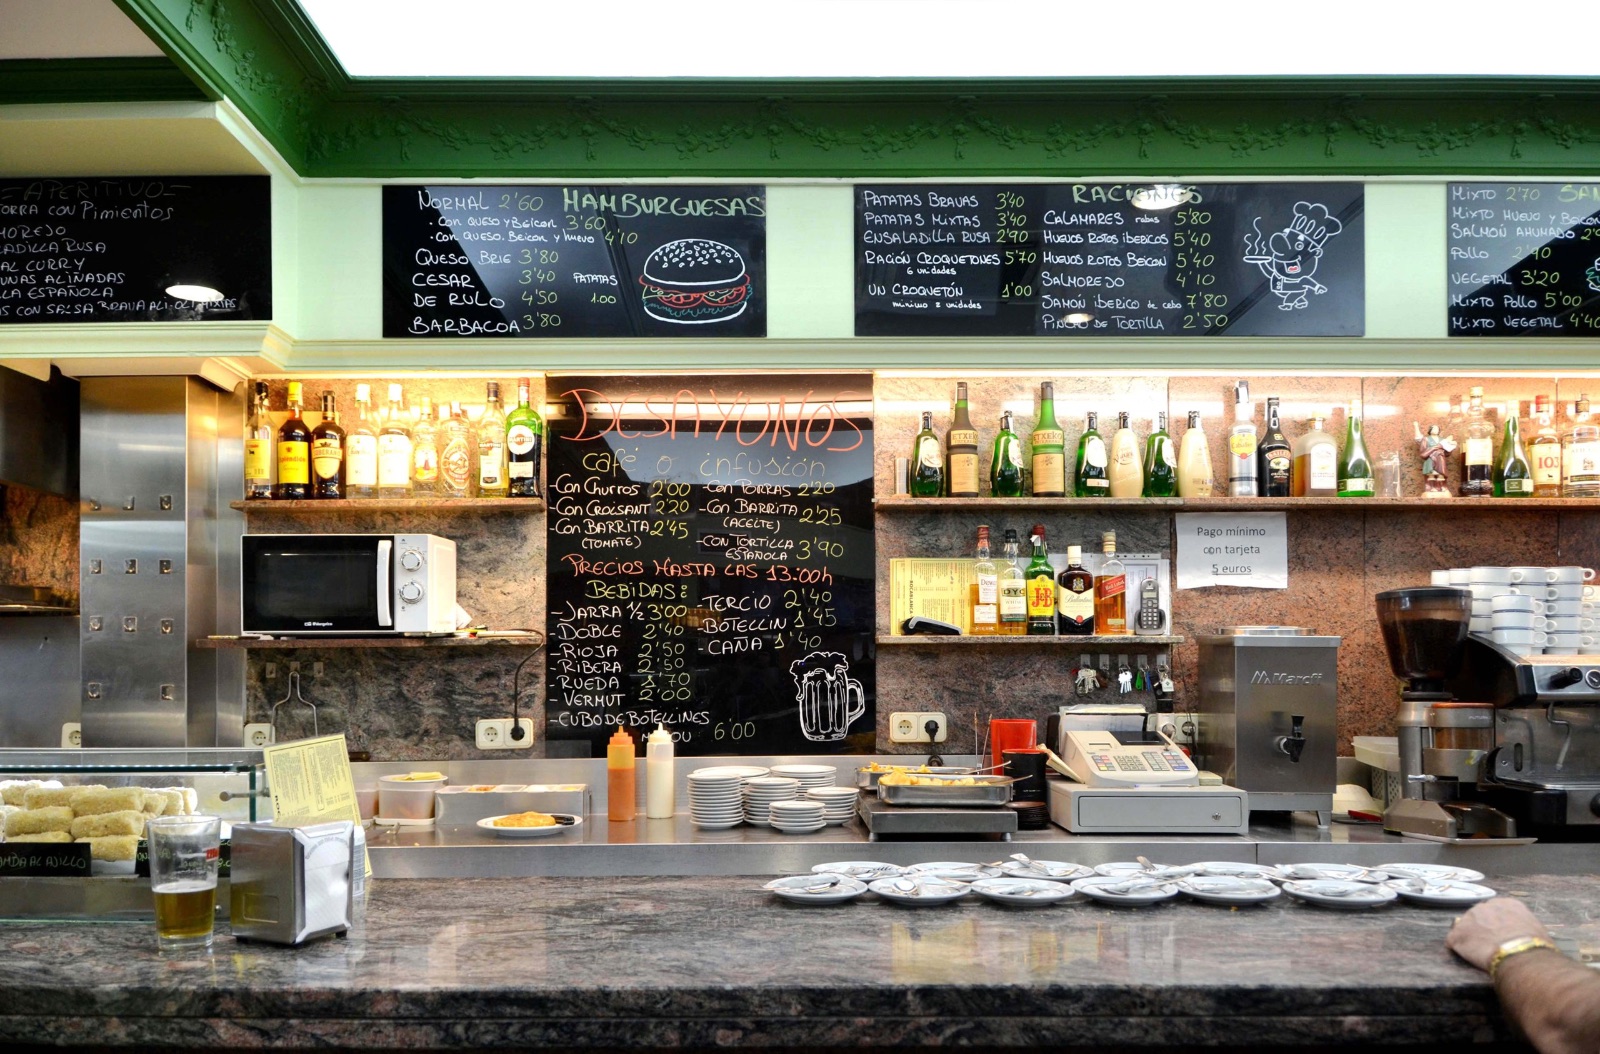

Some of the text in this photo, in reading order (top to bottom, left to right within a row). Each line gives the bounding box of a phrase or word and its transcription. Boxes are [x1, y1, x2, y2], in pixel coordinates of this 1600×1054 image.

[418, 190, 543, 210] NORMAL 2'60
[864, 191, 1024, 209] PATATAS BRAVAS 3'40
[1506, 186, 1540, 202] 2'70
[48, 205, 75, 216] CON
[81, 201, 173, 220] Pimientos
[563, 188, 766, 217] HAMBURGUESAS
[468, 217, 500, 226] QUESO
[566, 215, 606, 230] 3'60
[864, 212, 924, 226] PATATAS
[997, 211, 1026, 227] 3'40
[1044, 210, 1124, 225] CALAMARES
[1174, 208, 1211, 225] 5'80
[1503, 210, 1540, 221] HUEVO
[605, 228, 638, 246] 4'10
[864, 229, 1028, 244] ENSALADILLA RUSA 2'90
[1044, 230, 1210, 246] HUEVOS ROTOS 5'40
[1516, 226, 1575, 238] AHUMADO
[62, 238, 106, 253] RUSA
[26, 258, 85, 271] CURRY
[416, 248, 558, 265] QUESO BRIE 3'80
[917, 252, 1000, 265] CROQUETONES
[1005, 250, 1036, 265] 5'70
[1043, 251, 1083, 265] HUEVOS
[1087, 255, 1121, 266] ROTOS
[1176, 248, 1214, 267] 5'40
[412, 268, 555, 288] CESAR 3'40
[917, 266, 957, 275] unidades
[1452, 270, 1560, 286] VEGETAL 3'20
[573, 273, 618, 285] PATATAS
[1042, 271, 1215, 288] SALMOREJO 4'10
[28, 286, 113, 299] ESPAÑOLA
[868, 282, 1032, 298] UN CROQUETÓN 1'00
[414, 289, 557, 308] DE RULO 4'50
[946, 300, 982, 309] unidades
[1186, 292, 1227, 308] 7'80
[1544, 291, 1581, 308] 5'00
[17, 305, 40, 315] CON
[408, 312, 561, 335] BARBACOA 3'80
[1094, 319, 1108, 328] DE
[1183, 312, 1228, 329] 2'50
[1504, 315, 1562, 328] VEGETAL
[560, 388, 864, 451] DESAYUNOS
[582, 446, 639, 477] café
[700, 452, 826, 478] infusión
[1538, 457, 1559, 469] 103
[584, 477, 691, 497] Churros 2'00
[735, 479, 835, 497] PORRAS 2'20
[656, 499, 689, 515] 2'20
[799, 505, 842, 526] 2'25
[650, 520, 688, 539] 2'45
[1197, 526, 1265, 538] Pago mínimo
[796, 537, 844, 559] 3'90
[1204, 546, 1260, 555] con tarjeta
[561, 554, 644, 577] PRECIOS
[653, 557, 715, 576] HASTA
[724, 564, 758, 579] LAS
[1212, 564, 1218, 573] 5
[784, 588, 831, 609] 2'40
[647, 604, 687, 620] 3'00
[794, 608, 837, 627] 1'45
[643, 623, 684, 639] 2'40
[774, 631, 821, 650] 1'40
[638, 642, 684, 659] 2'50
[638, 658, 684, 674] 2'50
[639, 688, 691, 701] 2'00
[626, 708, 710, 727] BOTELLINES
[714, 718, 756, 741] 6'00
